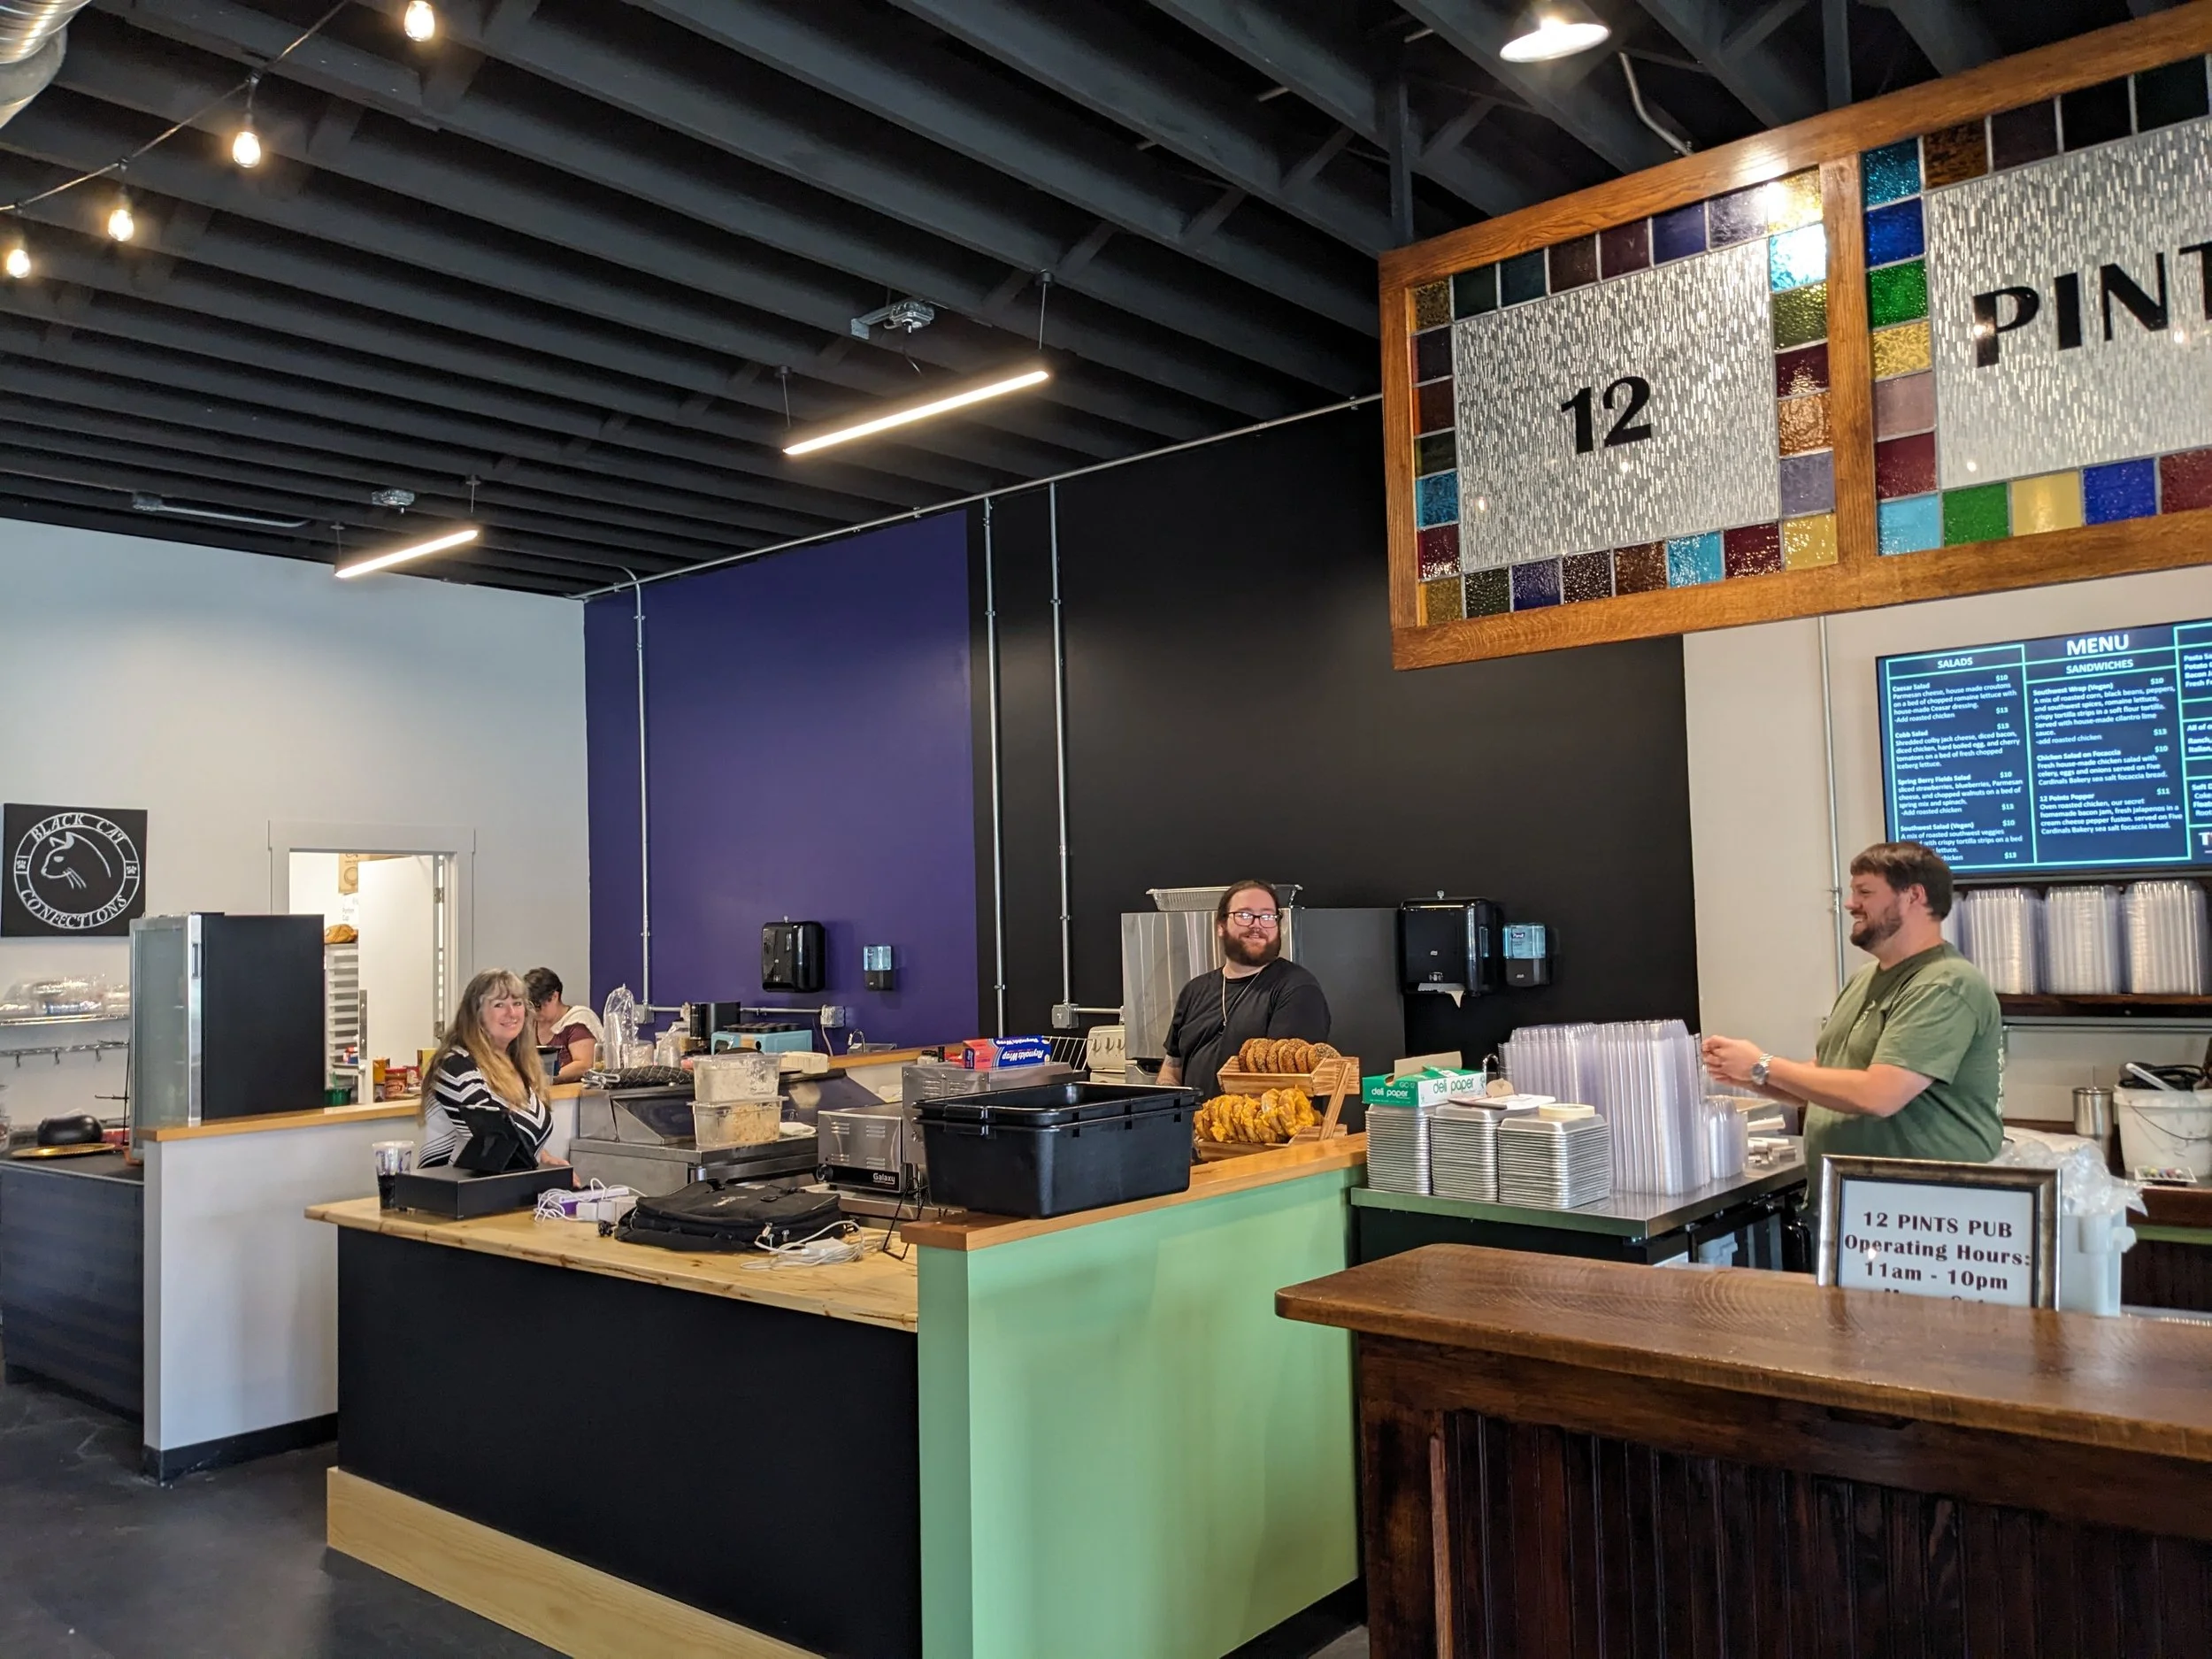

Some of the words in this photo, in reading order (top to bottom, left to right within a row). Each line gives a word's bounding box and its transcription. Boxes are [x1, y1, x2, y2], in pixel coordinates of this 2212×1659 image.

[1561, 376, 1652, 455] 12
[2066, 634, 2129, 656] MENU
[1938, 657, 1973, 669] SALADS
[2066, 659, 2133, 674] SANDWICHES
[29, 813, 86, 842] BLACK
[96, 820, 127, 845] CAT
[19, 889, 127, 928] CONFECTIONS
[1002, 1050, 1018, 1062] Wrap
[1018, 1048, 1044, 1060] Reynolds
[1433, 1079, 1448, 1094] deli
[1451, 1077, 1475, 1093] paper
[872, 1172, 895, 1185] Galaxy
[1863, 1210, 1888, 1228] 12
[1898, 1213, 1959, 1234] PINTS
[1968, 1219, 2013, 1239] PUB
[1844, 1234, 1947, 1262] Operating
[1956, 1244, 2032, 1266] Hours:
[1864, 1261, 1922, 1281] 11am
[1947, 1269, 2008, 1292] 10pm
